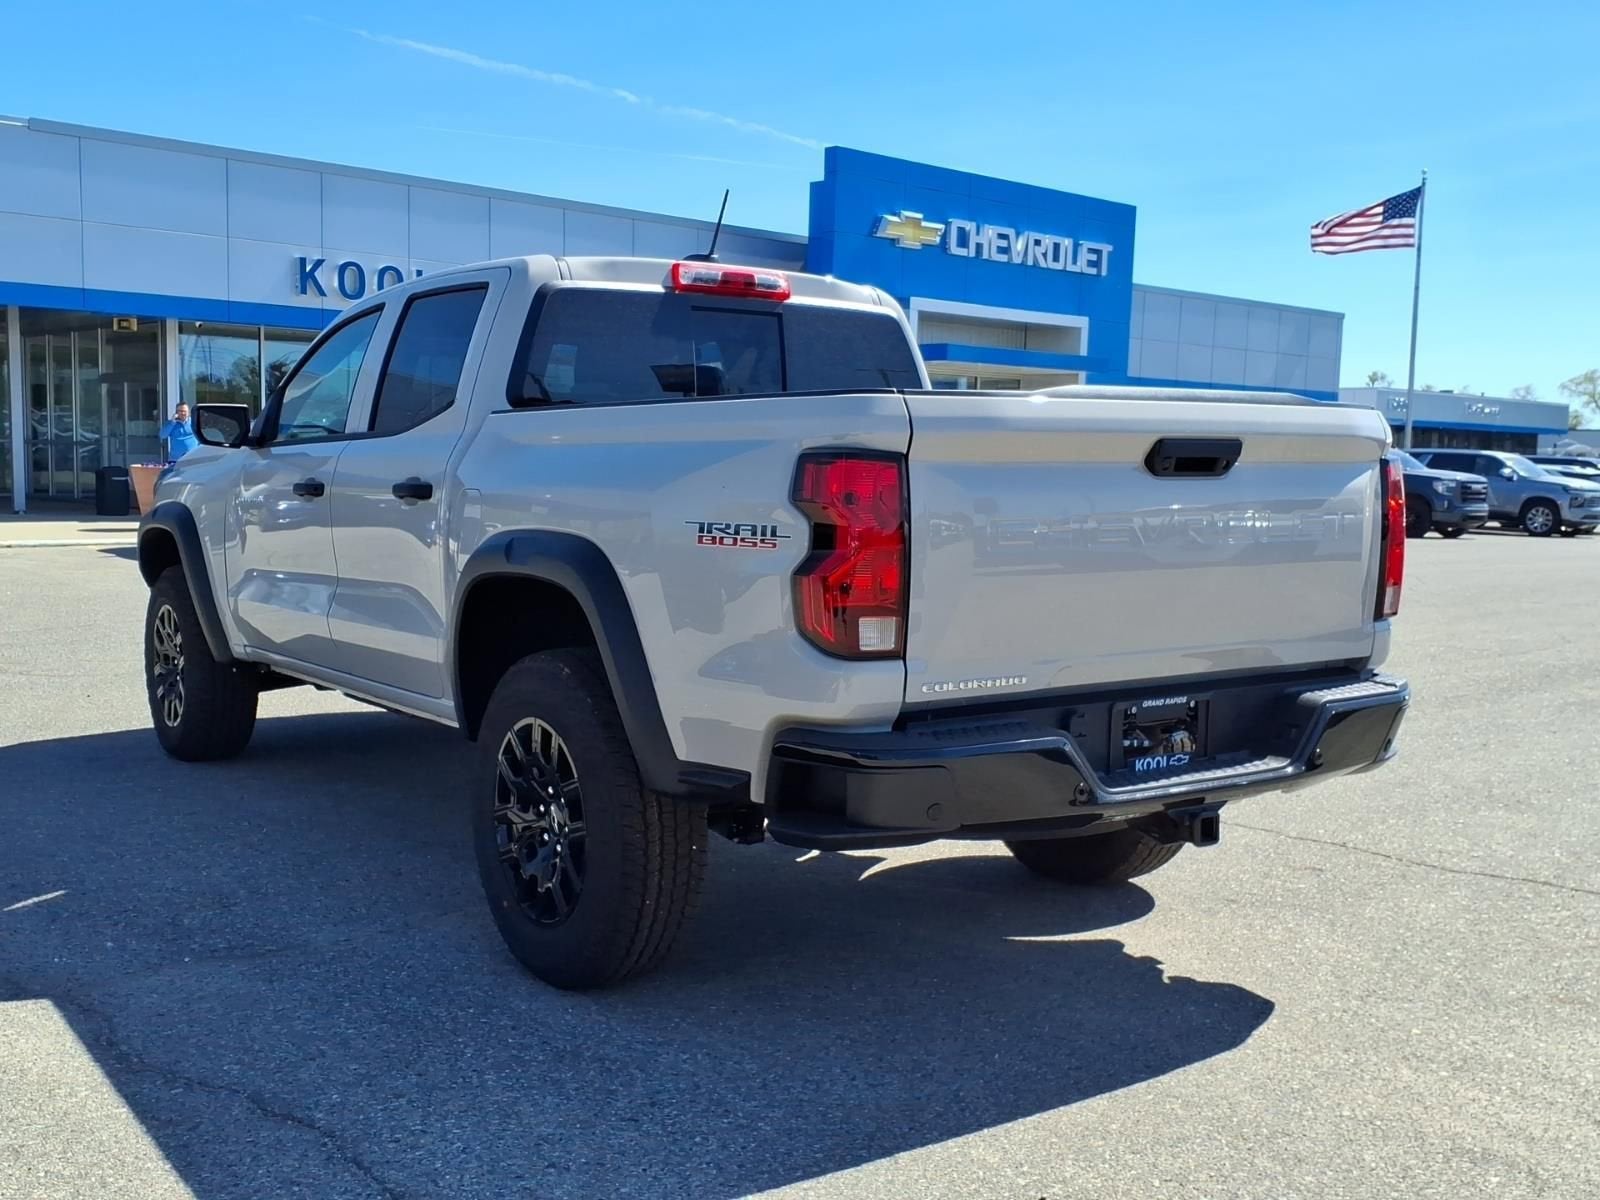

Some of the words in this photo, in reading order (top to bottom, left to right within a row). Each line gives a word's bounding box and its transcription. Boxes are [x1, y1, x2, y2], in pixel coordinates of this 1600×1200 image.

[946, 218, 1113, 277] CHEVROLET
[297, 256, 423, 301] KOO
[684, 521, 791, 538] TRAIL
[697, 535, 778, 550] BOSS
[921, 676, 1028, 693] COLORADO
[1142, 698, 1164, 707] GRAND
[1165, 696, 1188, 705] RAPIDS
